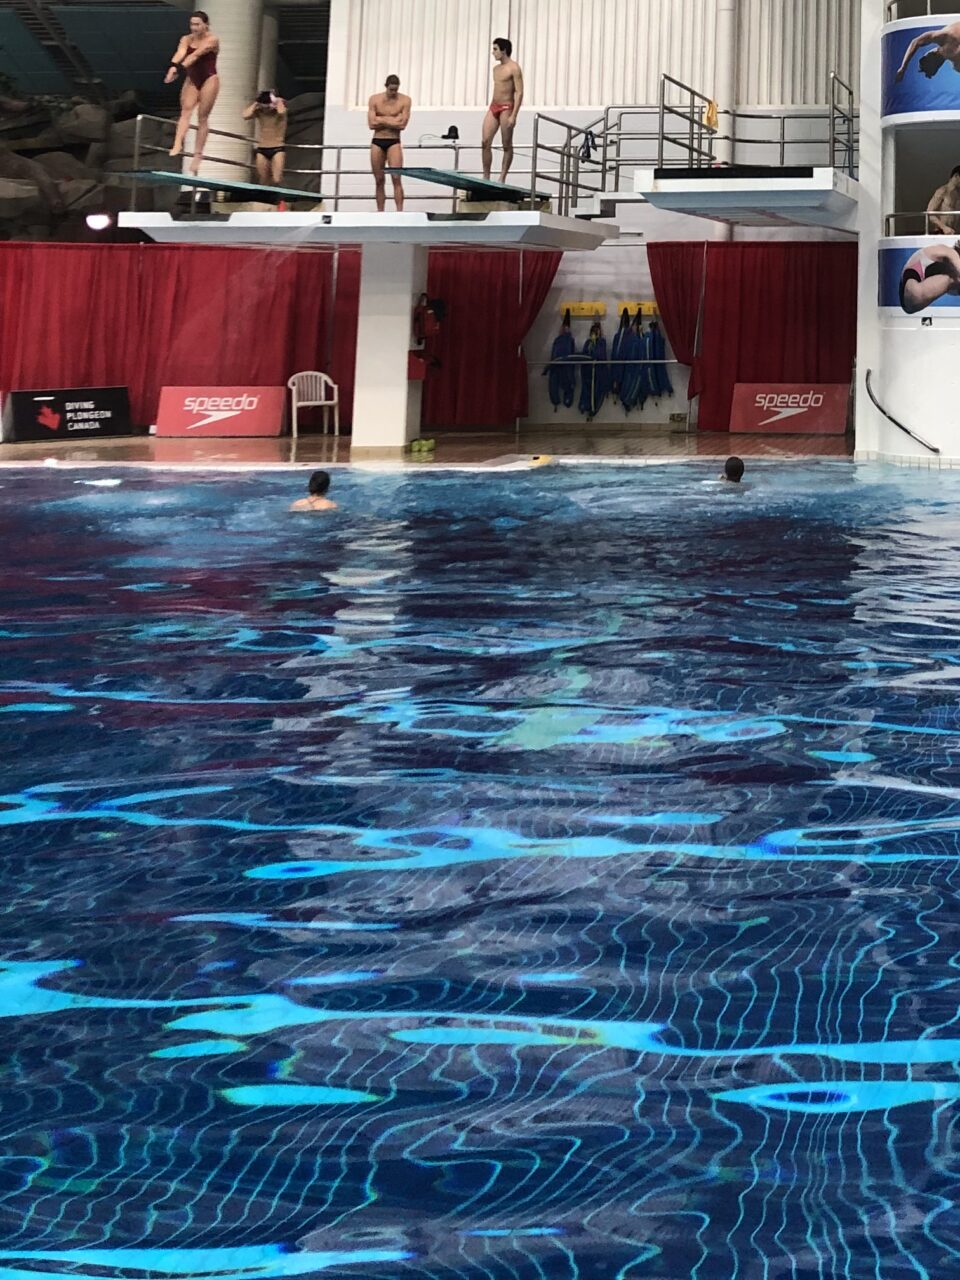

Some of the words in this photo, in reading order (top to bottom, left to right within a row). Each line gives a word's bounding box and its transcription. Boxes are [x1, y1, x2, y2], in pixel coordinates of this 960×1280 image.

[65, 400, 95, 411] DIVING
[183, 393, 258, 412] speedo
[754, 390, 824, 411] speedo
[66, 410, 112, 420] PLONGEON
[67, 421, 101, 431] CANADA
